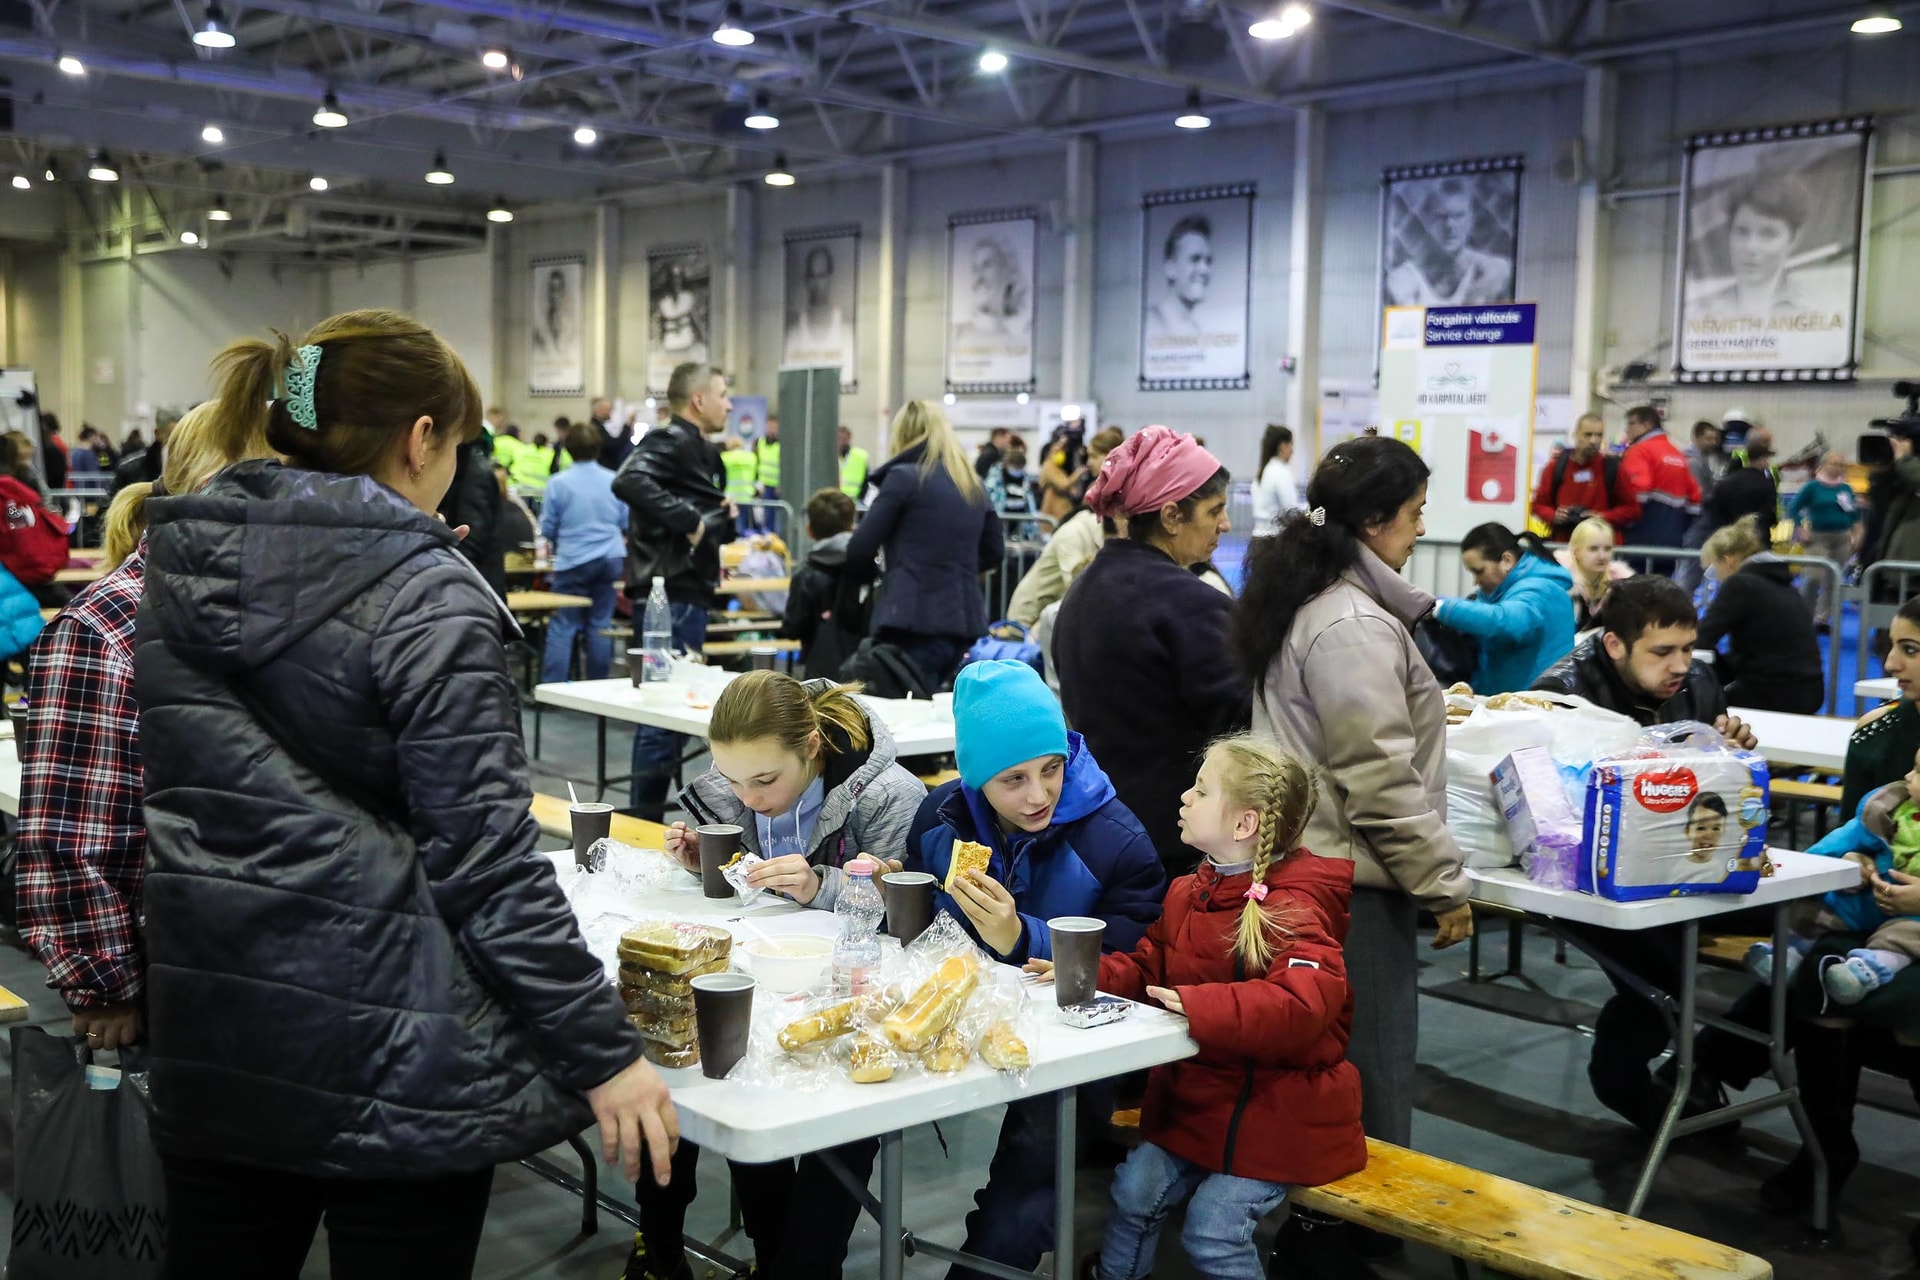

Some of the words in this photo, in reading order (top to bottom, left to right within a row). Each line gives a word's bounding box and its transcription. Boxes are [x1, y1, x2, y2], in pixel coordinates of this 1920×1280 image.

[1426, 312, 1472, 328] Forgalmi
[1474, 310, 1521, 324] változás
[1426, 330, 1462, 341] Service
[1464, 329, 1502, 342] change
